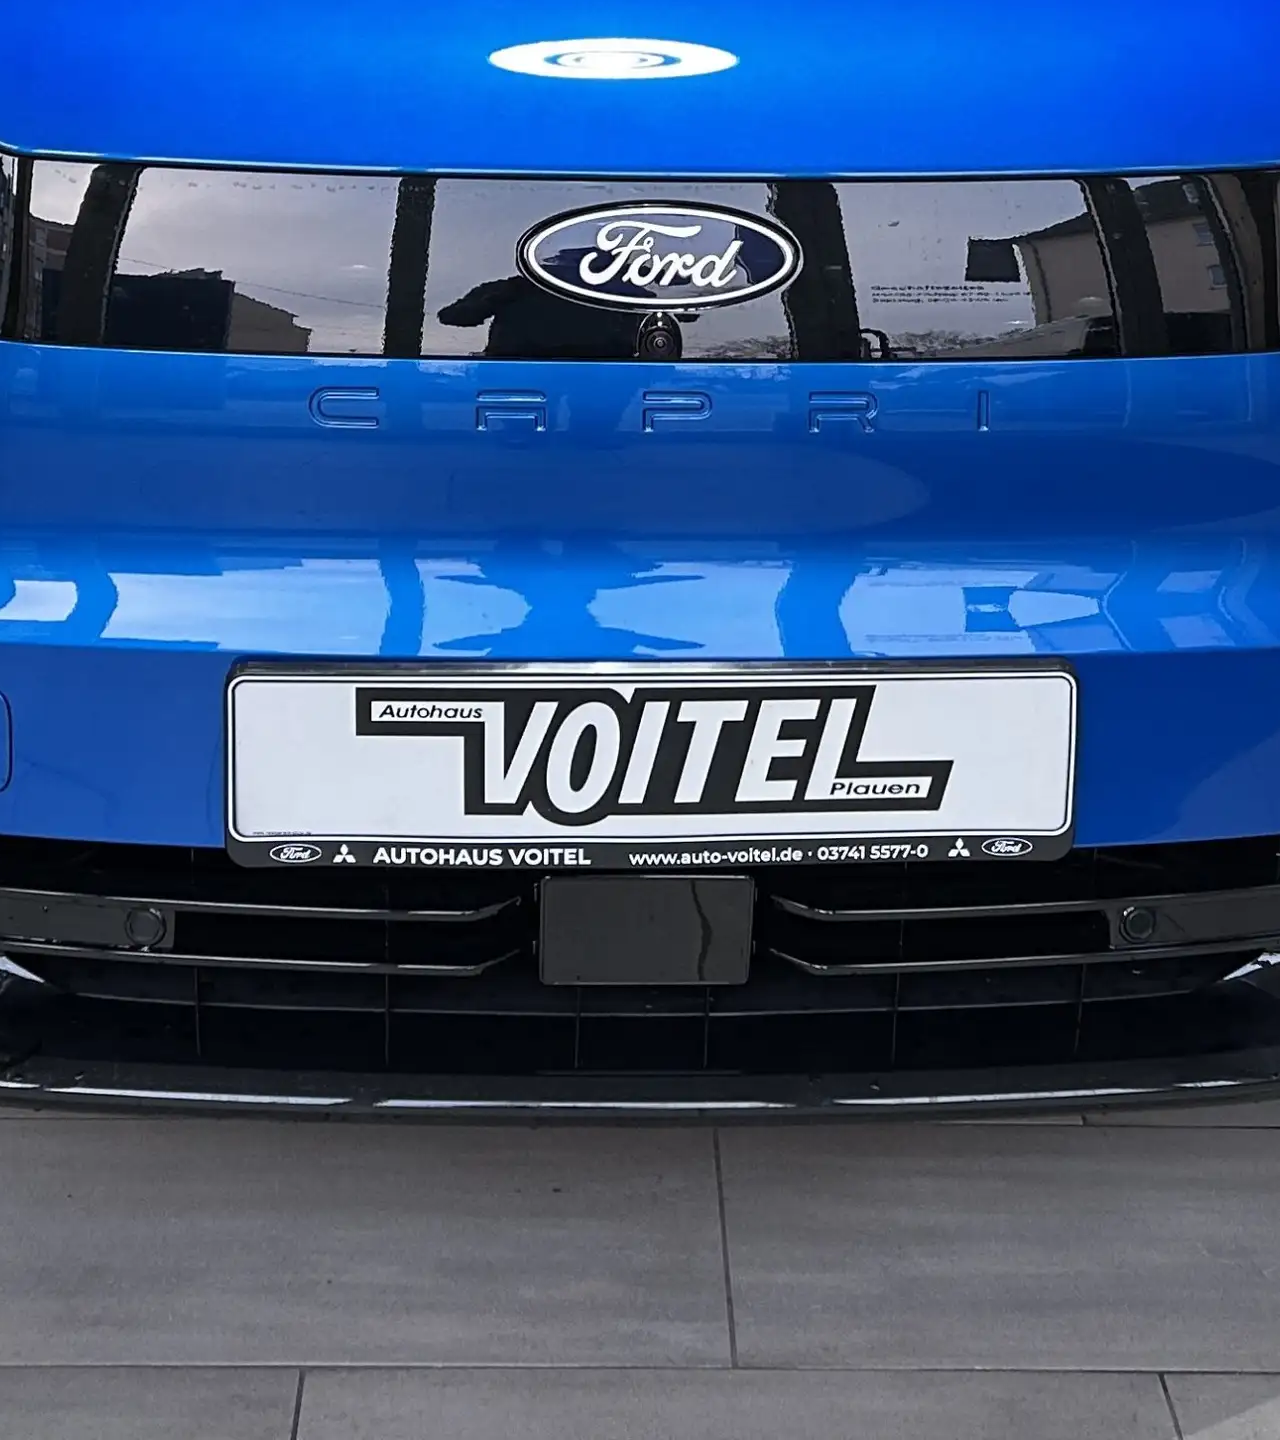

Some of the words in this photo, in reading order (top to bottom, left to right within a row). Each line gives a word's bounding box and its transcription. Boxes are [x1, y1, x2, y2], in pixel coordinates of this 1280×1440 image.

[579, 220, 744, 288] Ford
[308, 386, 991, 432] CAPRI
[378, 702, 484, 720] Autohaus
[484, 697, 858, 814] VOITEL
[830, 779, 921, 796] Plauen
[372, 847, 504, 866] AUTOHAUS
[506, 848, 592, 866] VOITEL
[628, 847, 804, 866] www.auto-voitel.de
[817, 846, 866, 861] 03741
[869, 844, 929, 859] 5577-0
